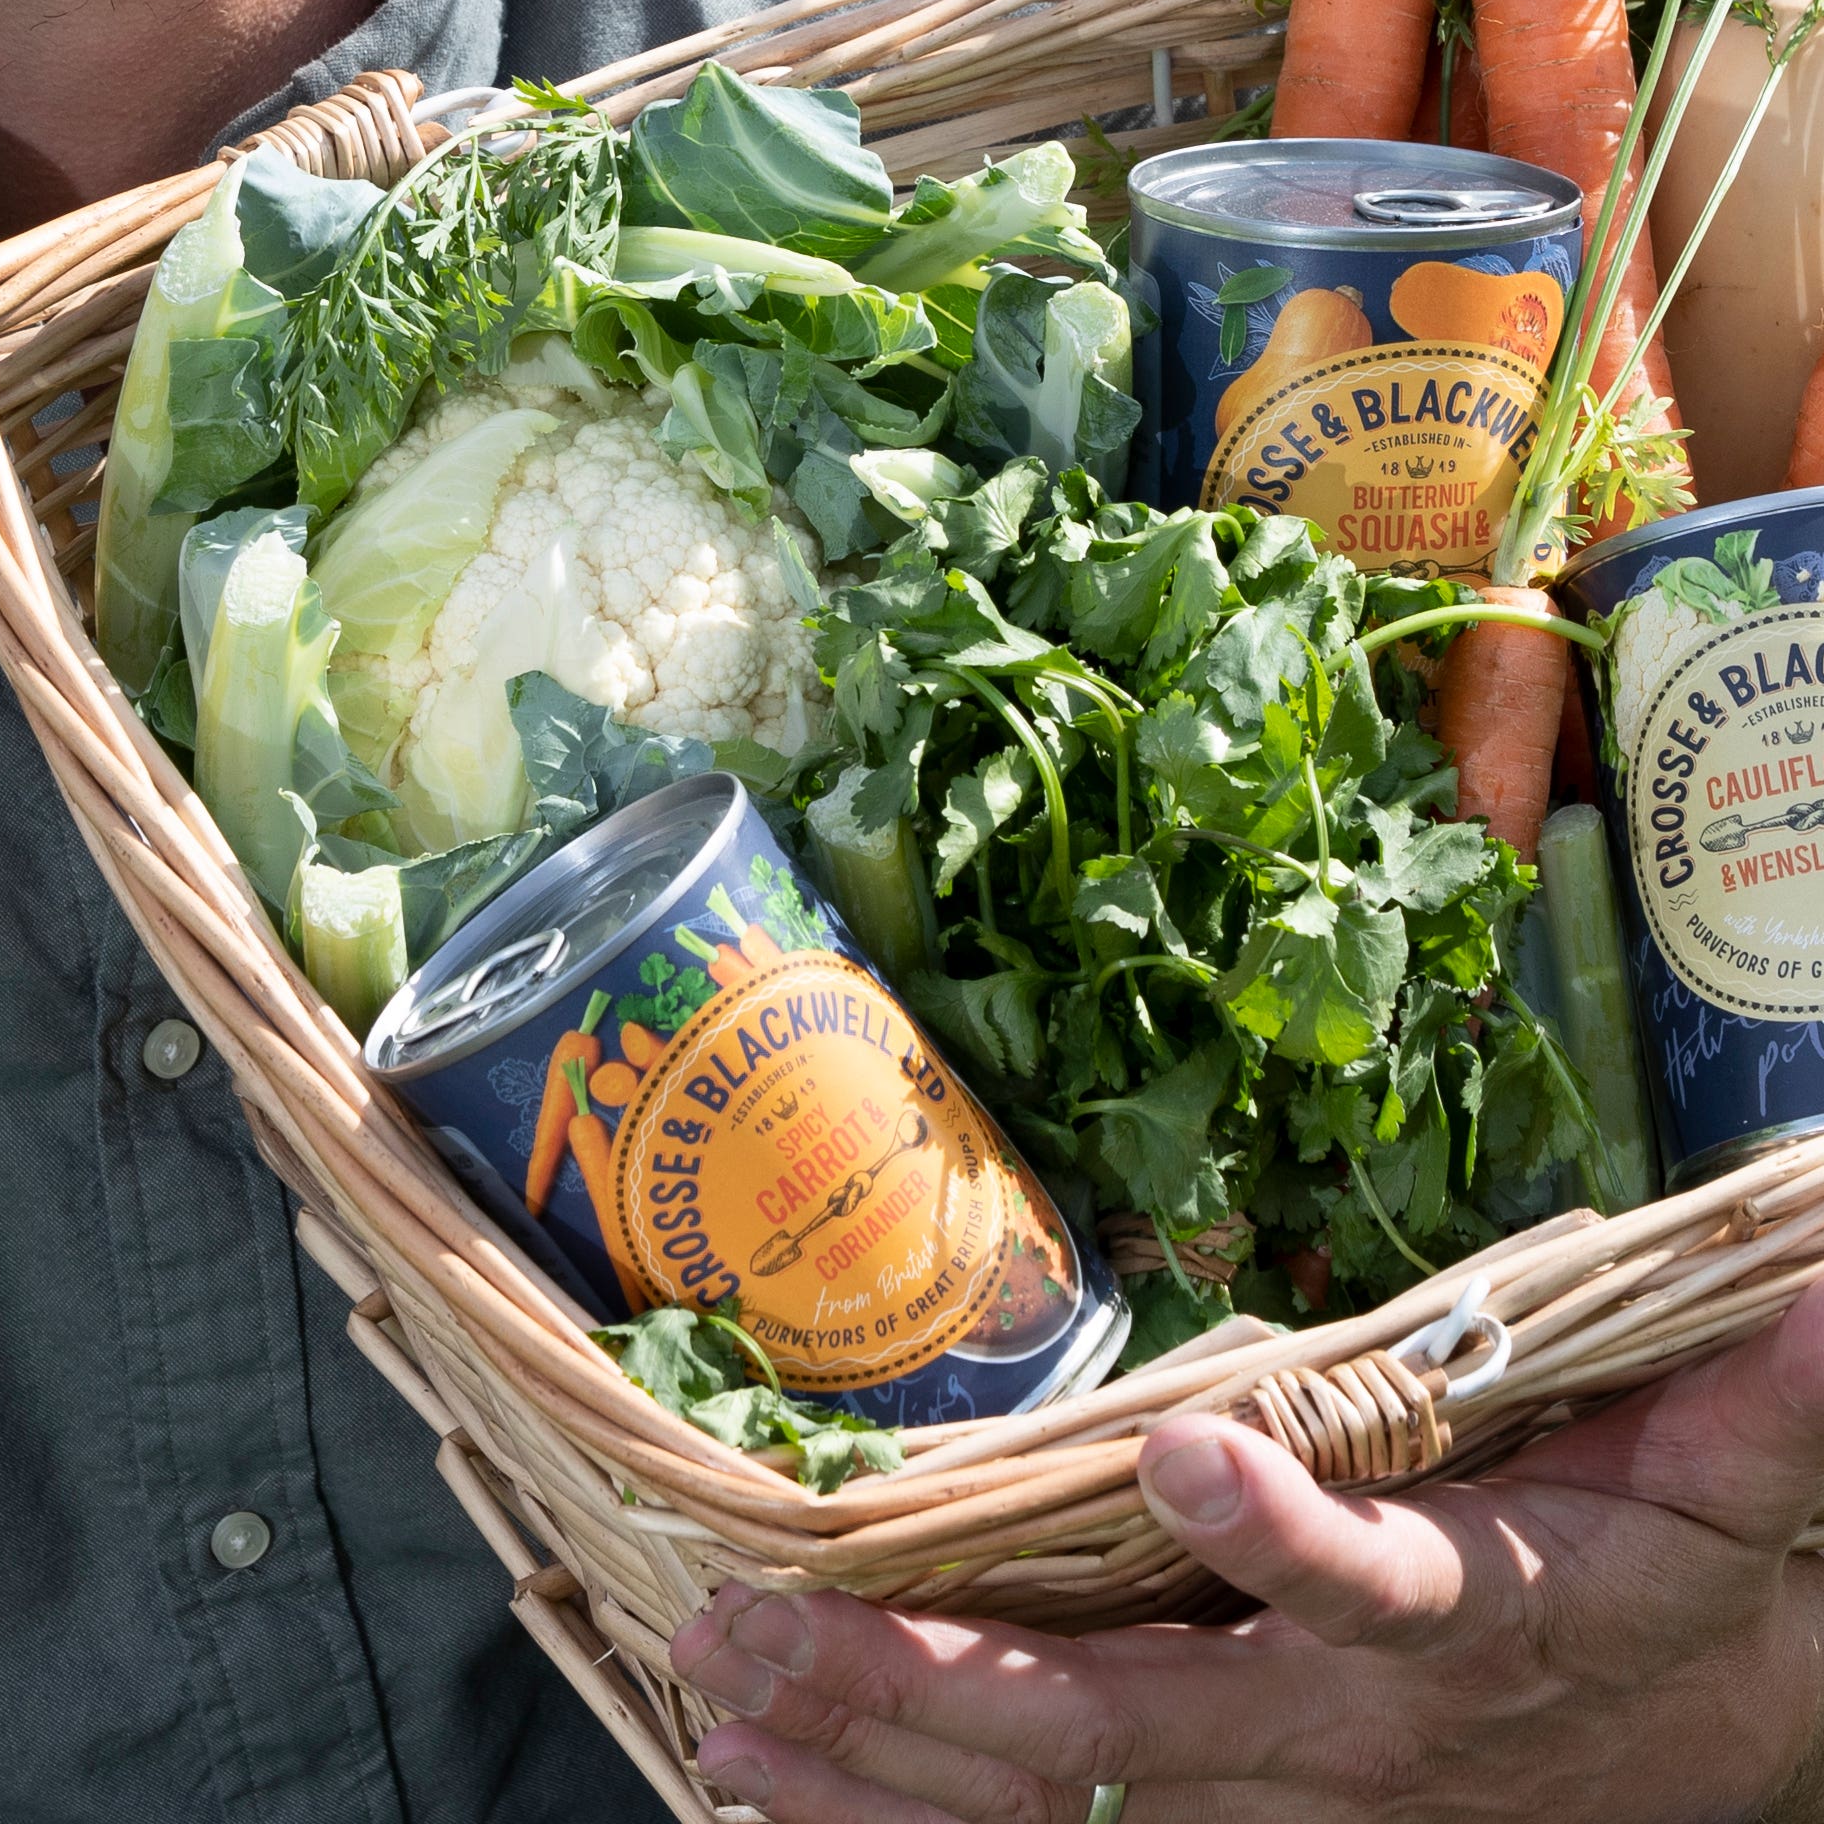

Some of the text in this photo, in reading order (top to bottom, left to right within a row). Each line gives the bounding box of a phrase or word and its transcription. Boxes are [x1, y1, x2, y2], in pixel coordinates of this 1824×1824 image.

[1312, 403, 1350, 445] &
[1352, 379, 1540, 476] BLACKWE
[1353, 481, 1478, 510] BUTTERNUT
[1381, 459, 1456, 476] 18 19
[1337, 509, 1491, 553] SQUASH &
[1761, 732, 1781, 748] 18
[1656, 719, 1711, 890] CROSSE
[1687, 691, 1730, 729] &
[1686, 913, 1770, 976] PURVEYORS
[1777, 960, 1802, 979] OF
[1723, 913, 1757, 937] with
[754, 1078, 817, 1137] 18 19
[776, 1102, 831, 1161] SPICY
[649, 991, 946, 1309] CROSSE & BLACKWELL LTD
[756, 1097, 891, 1226] CARROT &
[753, 1132, 984, 1349] PURVEYORS OF GREAT BRITISH SOUPS
[814, 1169, 933, 1281] CORIANDER
[813, 1287, 871, 1326] from
[876, 1234, 939, 1300] British
